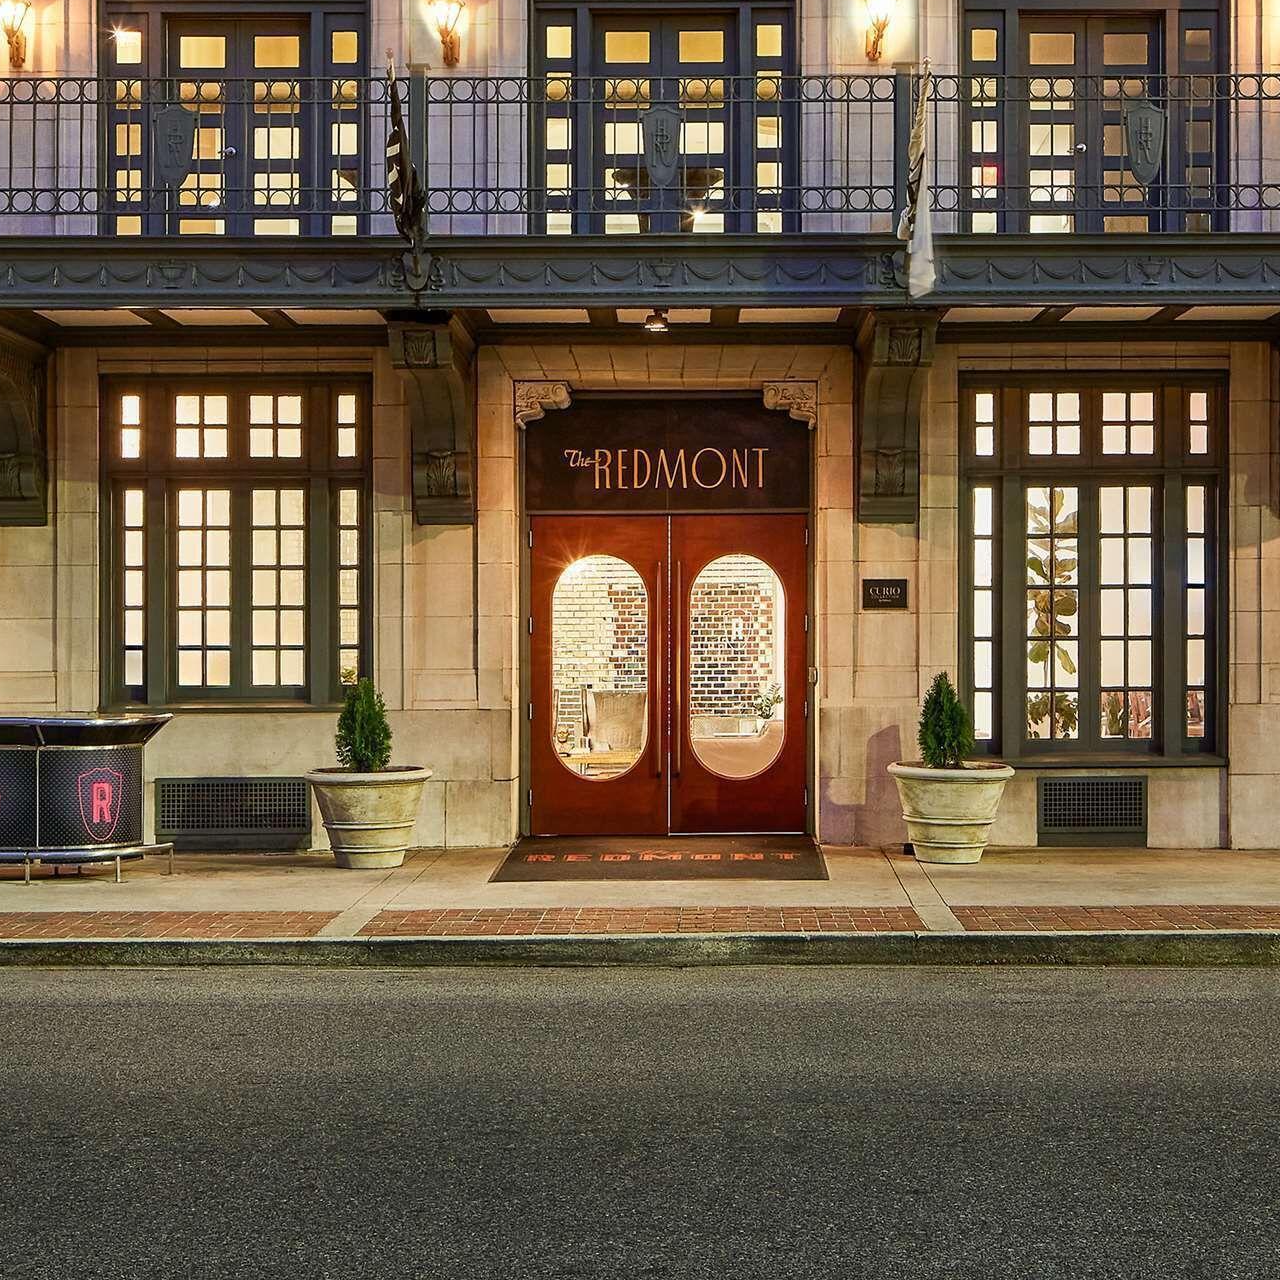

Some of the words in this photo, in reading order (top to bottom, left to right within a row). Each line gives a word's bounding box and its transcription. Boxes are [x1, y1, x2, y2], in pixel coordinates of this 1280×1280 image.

[564, 449, 600, 468] The
[594, 447, 769, 489] REDMONT
[869, 586, 901, 595] CURIO
[91, 781, 113, 823] R
[526, 853, 801, 862] REDMONT
